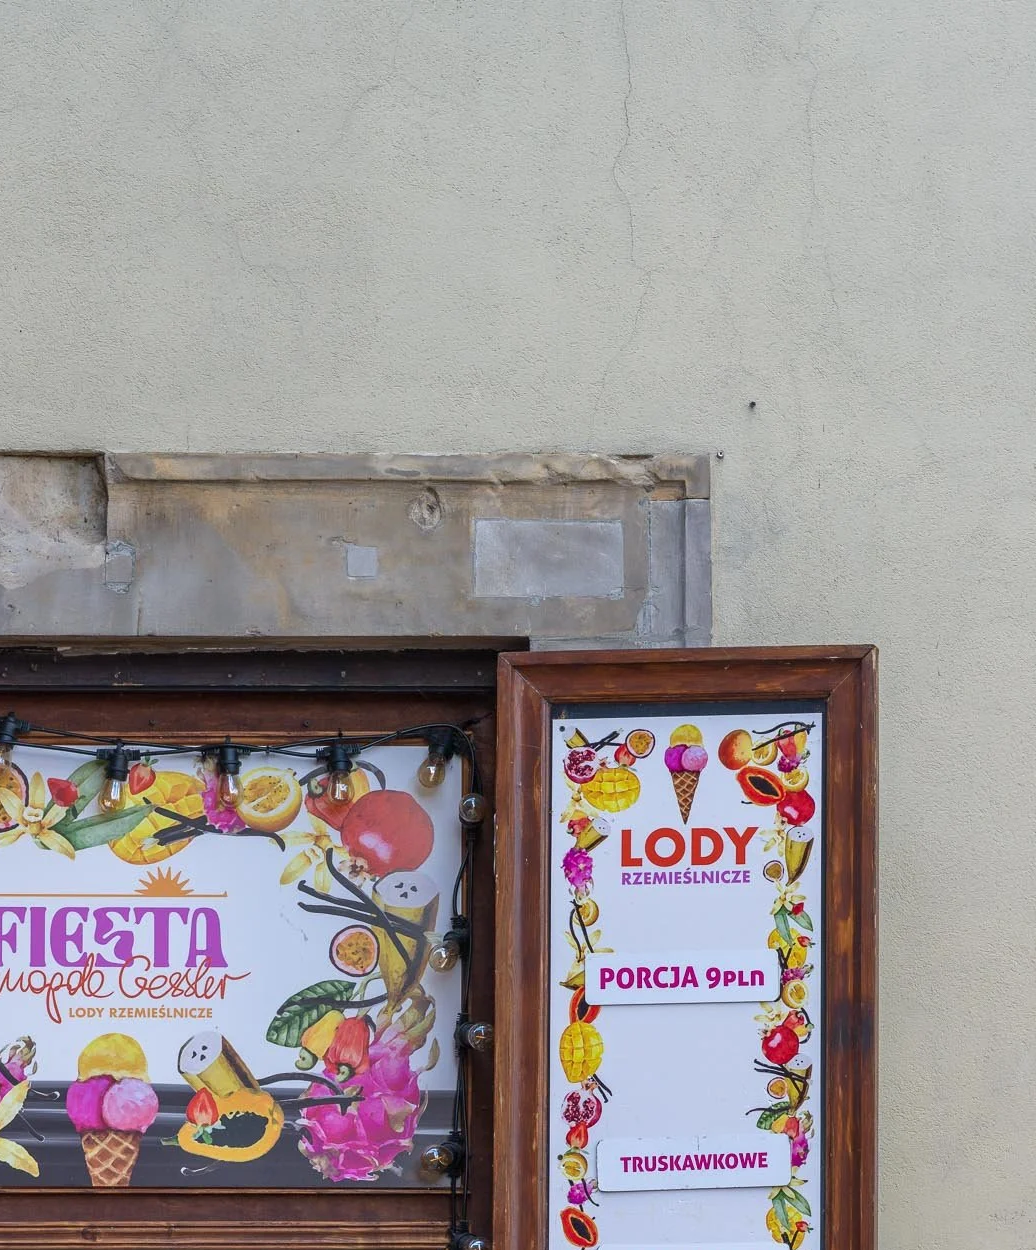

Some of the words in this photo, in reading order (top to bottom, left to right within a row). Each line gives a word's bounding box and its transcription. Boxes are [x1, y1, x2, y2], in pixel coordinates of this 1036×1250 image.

[621, 827, 758, 867] LODY
[619, 866, 752, 888] RZEMIEŚLNICZE
[600, 966, 698, 989] PORCJA
[67, 1005, 104, 1020] LODY
[109, 1003, 214, 1020] RZEMIEŚLNICZE
[620, 1153, 767, 1172] TRUSKAWKOWE
